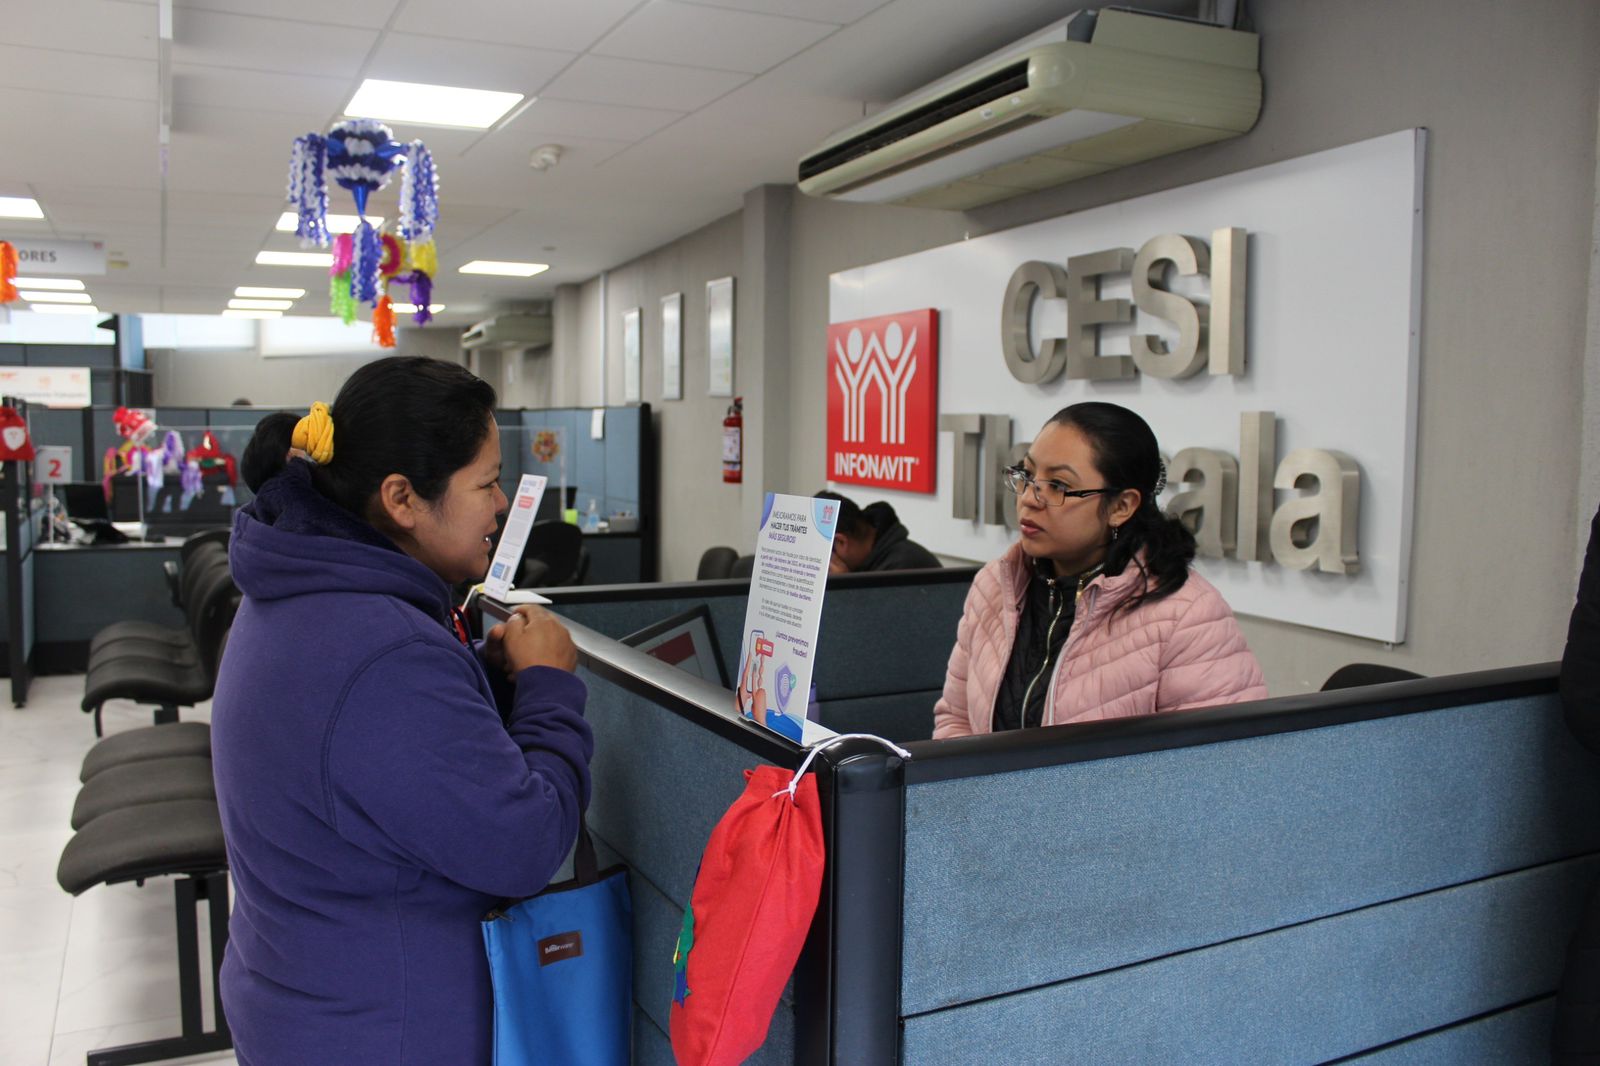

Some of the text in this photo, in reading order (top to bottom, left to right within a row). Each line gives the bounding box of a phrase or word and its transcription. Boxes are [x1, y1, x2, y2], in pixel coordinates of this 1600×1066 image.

[19, 250, 57, 262] ORES
[1001, 227, 1247, 385] CESI
[48, 459, 62, 477] 2
[835, 452, 915, 482] INFONAVIT
[940, 411, 1360, 574] Tlala
